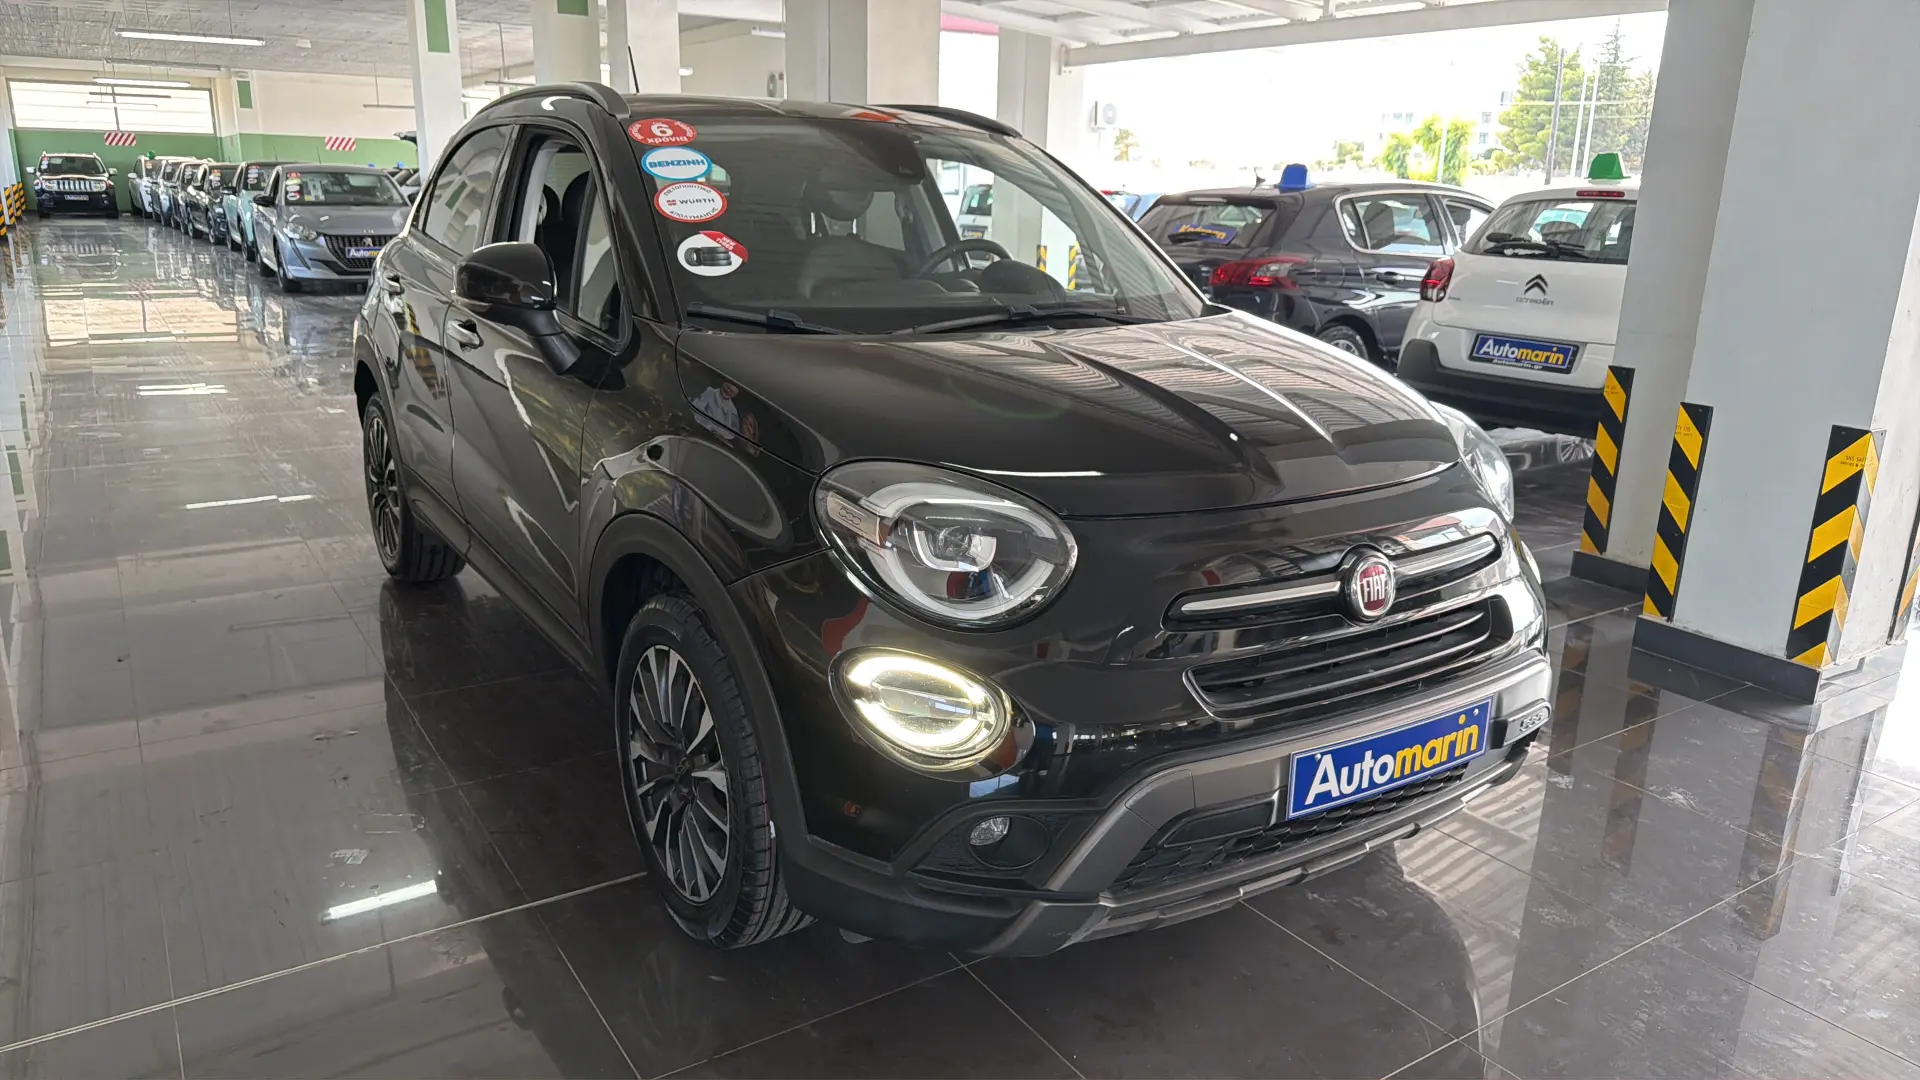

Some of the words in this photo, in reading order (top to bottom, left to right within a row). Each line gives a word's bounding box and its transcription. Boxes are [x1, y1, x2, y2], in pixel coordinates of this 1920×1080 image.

[647, 136, 689, 144] χρόνια
[651, 124, 673, 137] 6
[1479, 338, 1565, 365] Automarin
[1362, 575, 1388, 603] FIAT
[1304, 714, 1479, 806] Automarin
